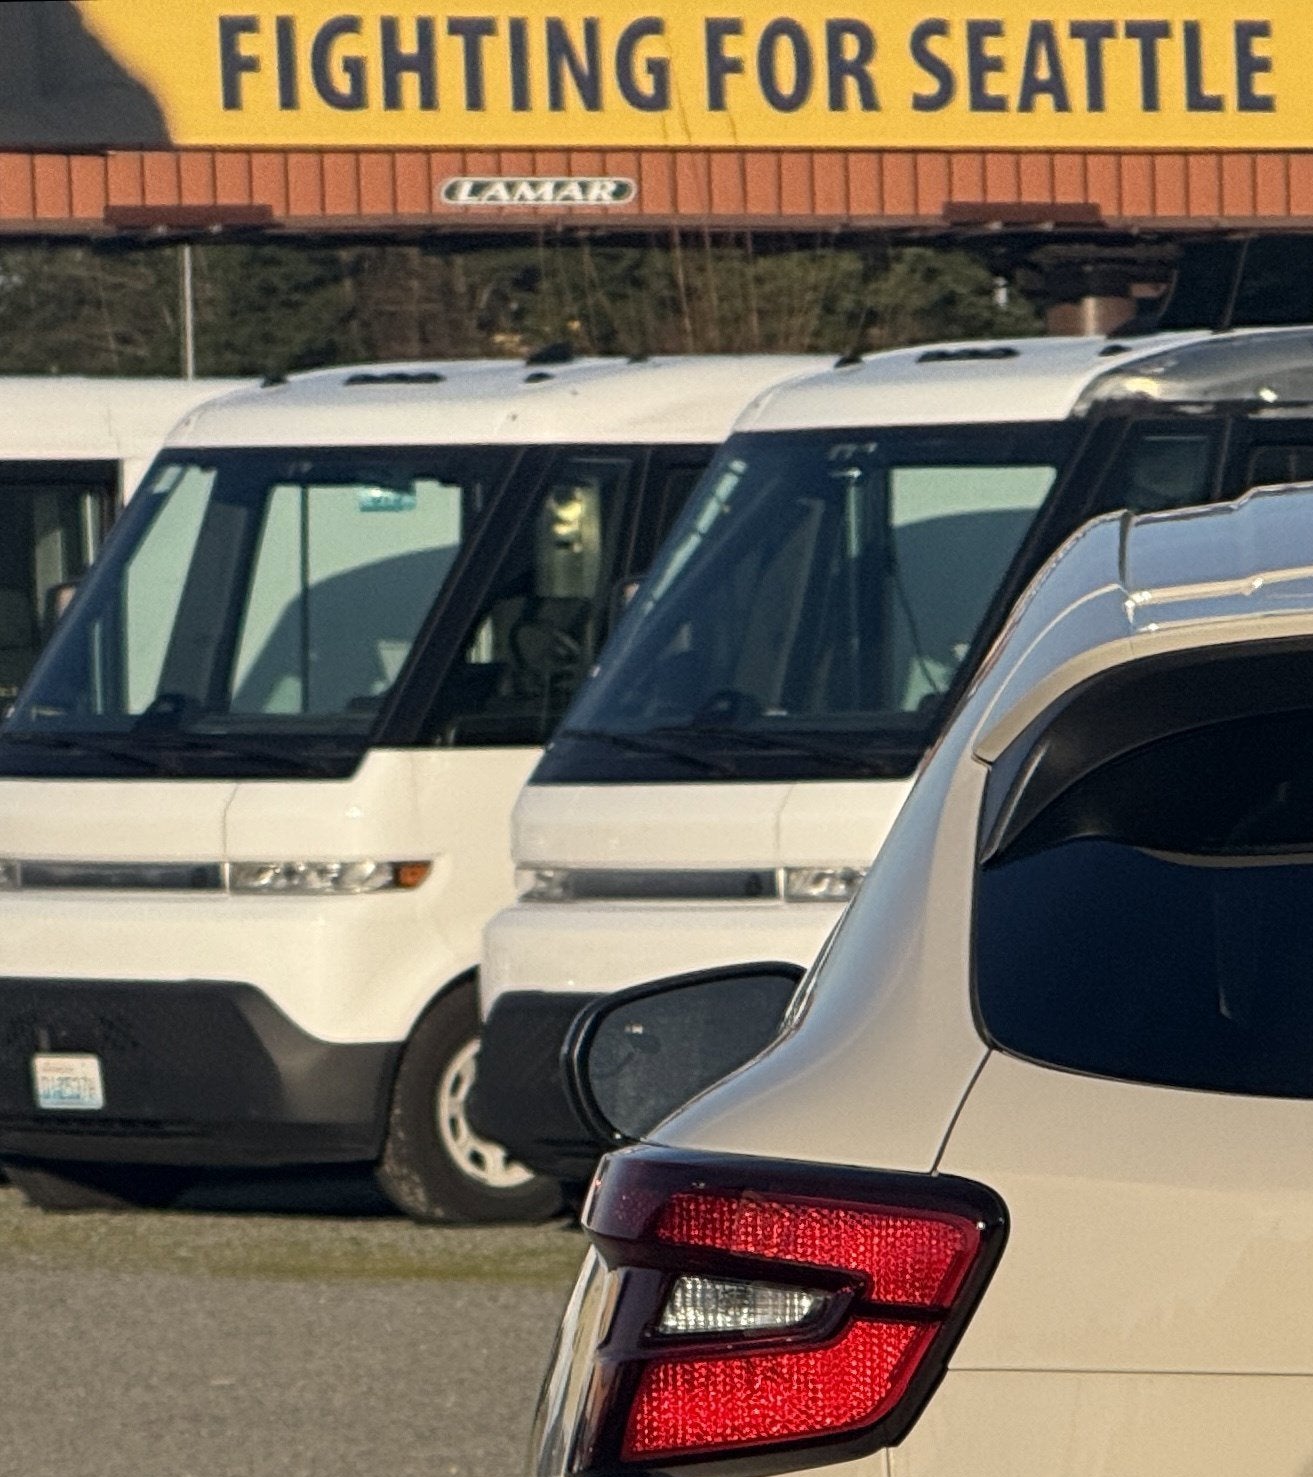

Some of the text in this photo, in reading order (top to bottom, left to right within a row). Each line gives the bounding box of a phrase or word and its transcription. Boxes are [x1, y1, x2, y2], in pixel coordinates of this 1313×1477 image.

[219, 14, 1276, 113] FIGHTING FOR SEATTLE
[457, 180, 617, 202] LAMAR
